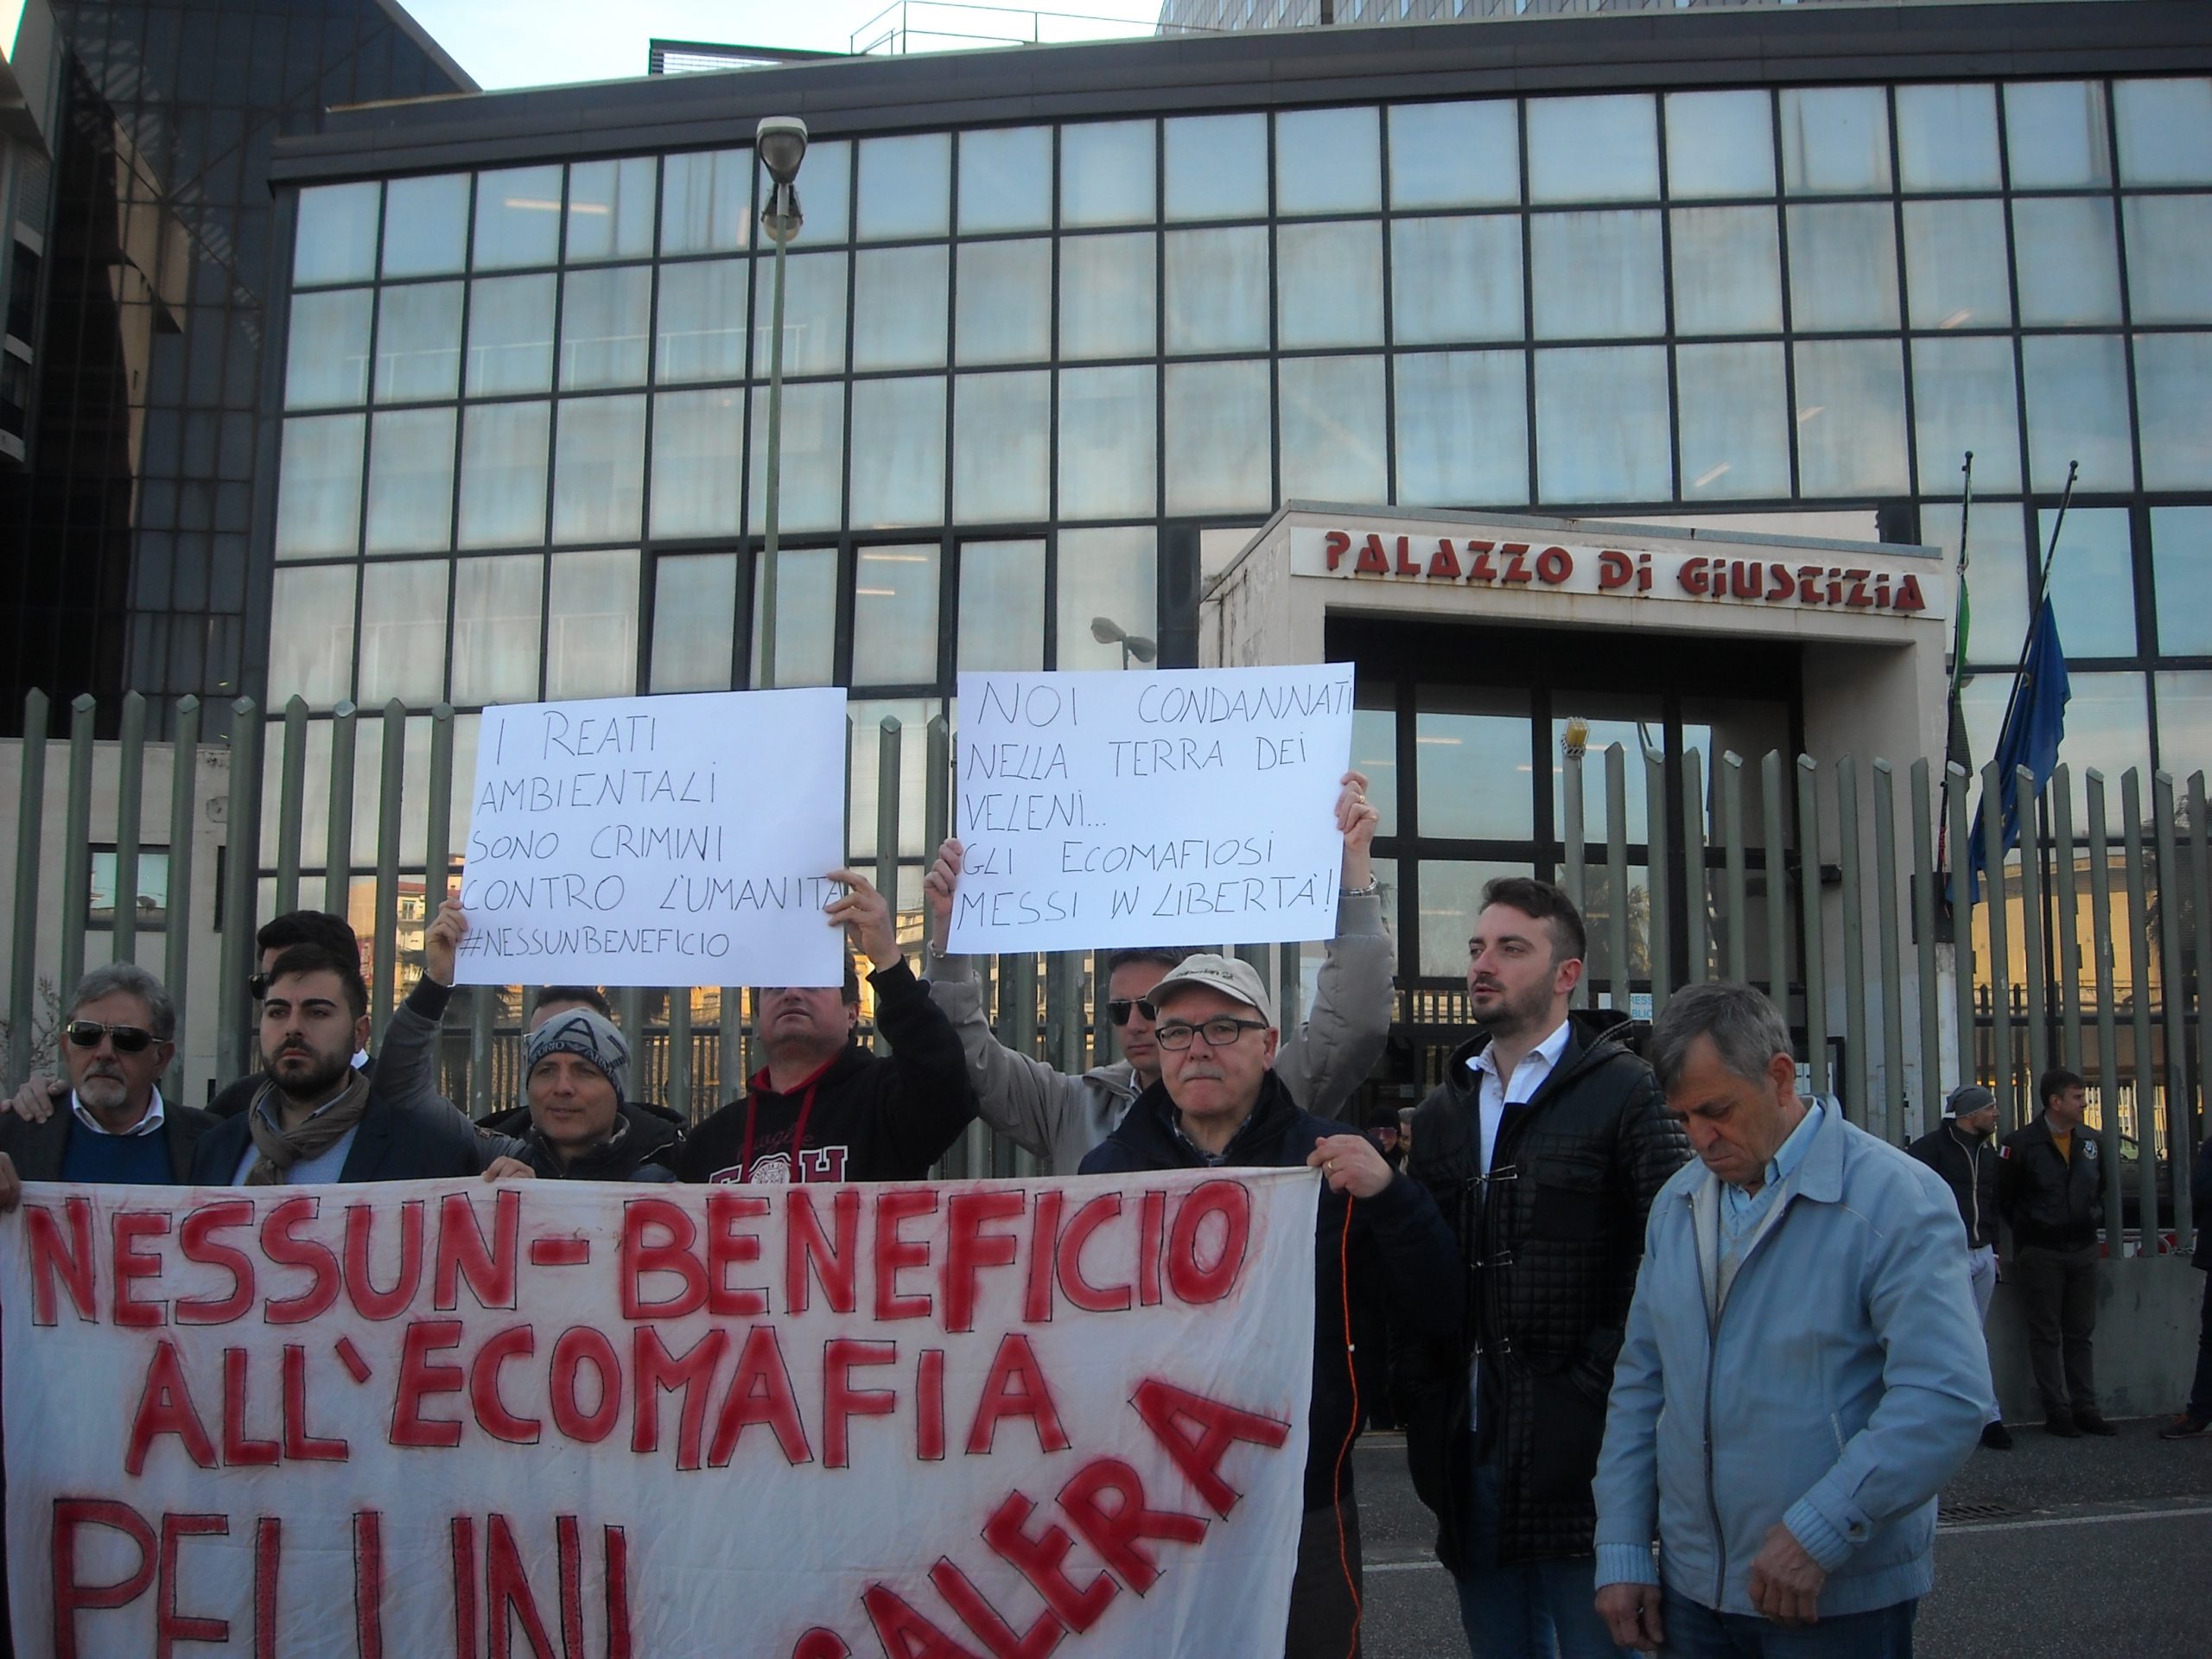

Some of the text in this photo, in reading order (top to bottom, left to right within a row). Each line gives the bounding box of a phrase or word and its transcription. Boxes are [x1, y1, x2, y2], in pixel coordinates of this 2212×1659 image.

[1325, 531, 1573, 584] PALAZZO
[977, 674, 1352, 728] NOI CONDANNATI
[496, 710, 656, 766] I REATI
[967, 742, 1068, 780] NELLA
[1109, 737, 1224, 777] TERRA
[477, 762, 716, 816] AMBIENTALI
[470, 824, 722, 864] SONO CRIMINI
[961, 830, 1274, 874] GLI ECOMAFIOSI
[462, 873, 626, 912] CONTRO
[957, 892, 1077, 931] MESSI
[459, 925, 730, 957] #NESSUNBENEFICIO
[621, 1179, 1251, 1333] BENEFICIO
[791, 1377, 1292, 1659] ALERA
